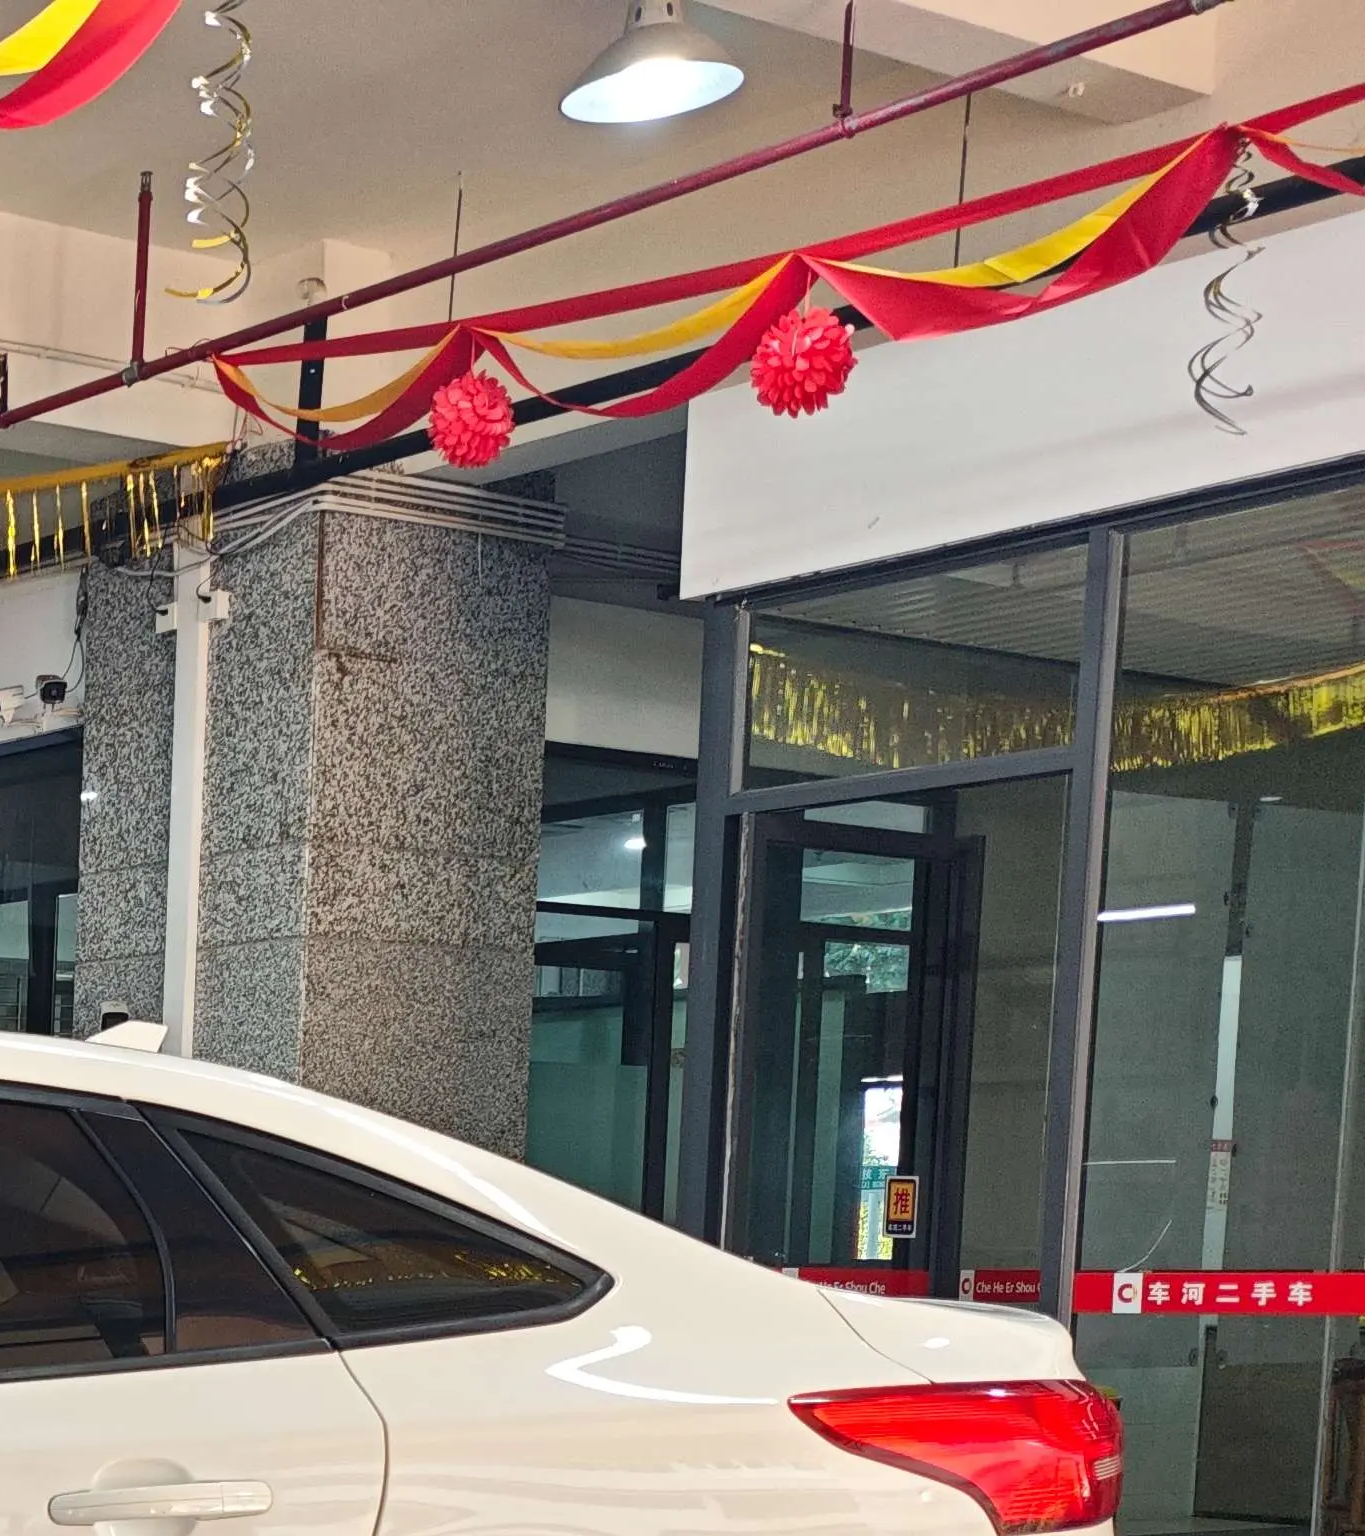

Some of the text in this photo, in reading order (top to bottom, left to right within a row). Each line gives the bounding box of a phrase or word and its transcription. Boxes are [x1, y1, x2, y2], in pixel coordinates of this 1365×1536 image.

[892, 1187, 910, 1215] 推
[869, 1281, 886, 1294] Che
[975, 1277, 991, 1293] Che
[992, 1278, 1003, 1293] He
[1004, 1279, 1014, 1293] Er
[1015, 1279, 1036, 1294] Shou
[1147, 1281, 1313, 1306] 车河二手车
